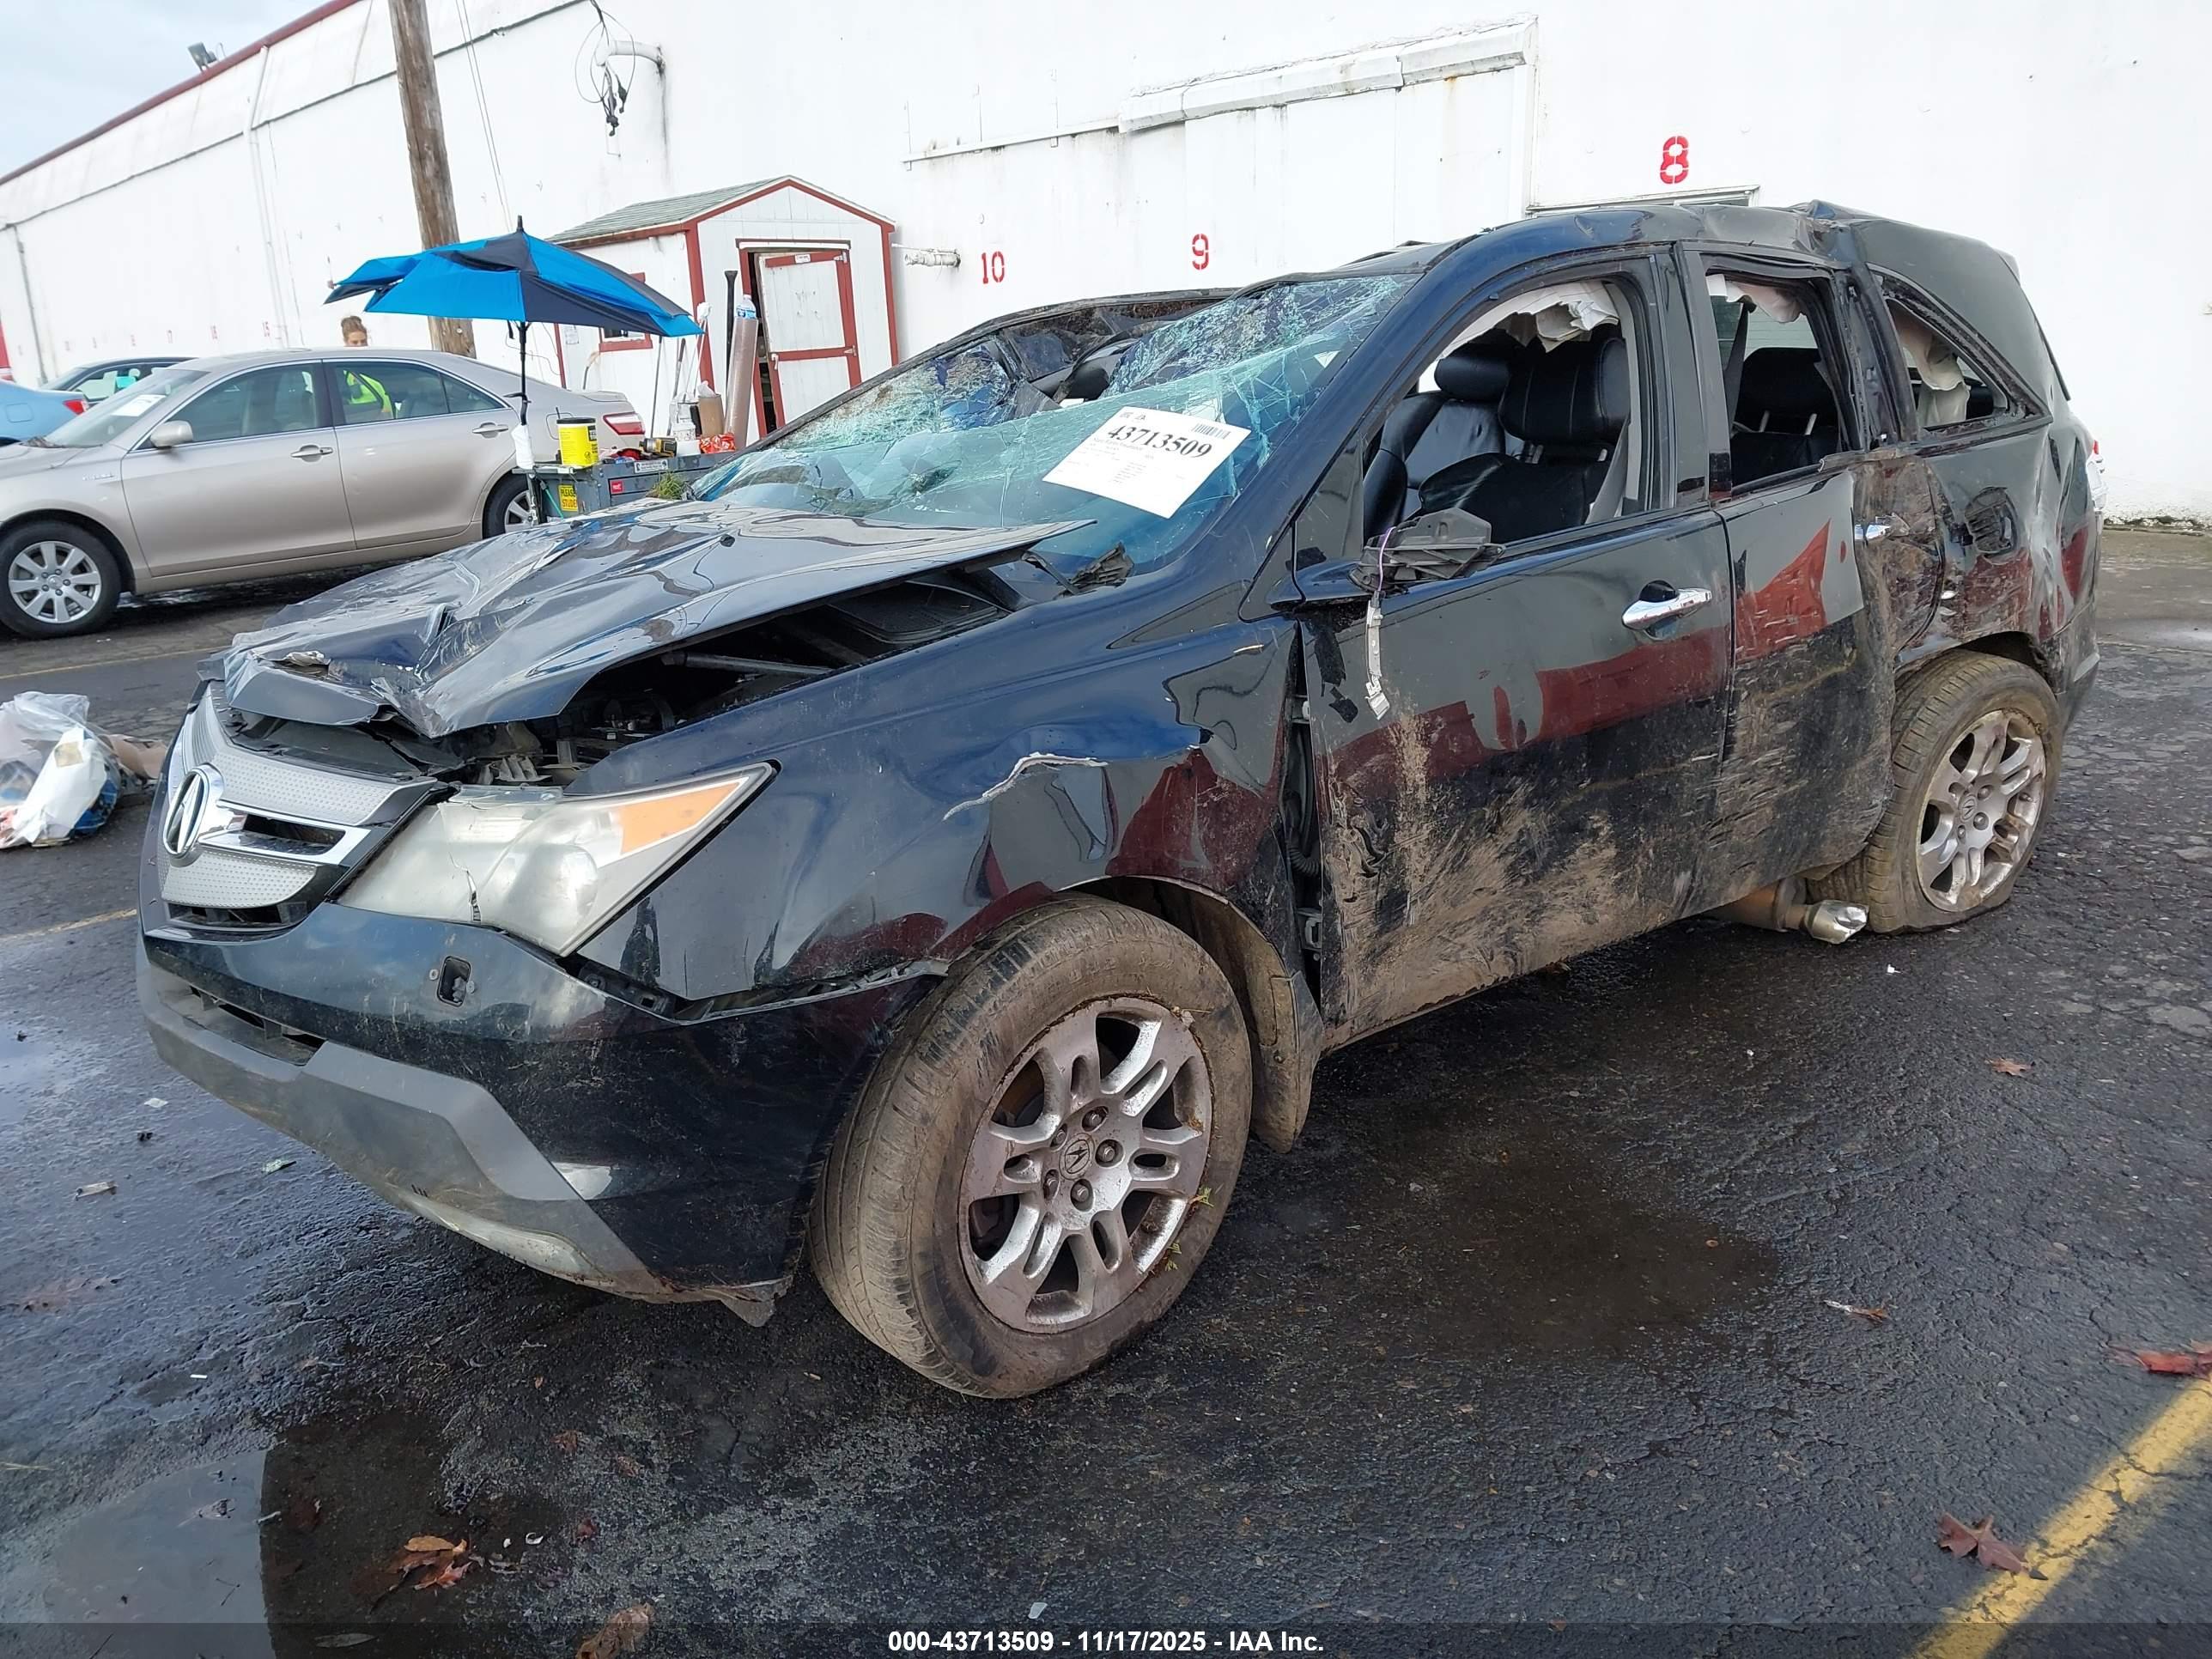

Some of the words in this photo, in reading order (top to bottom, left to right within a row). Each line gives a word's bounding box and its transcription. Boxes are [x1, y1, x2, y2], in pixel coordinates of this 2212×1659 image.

[1660, 136, 1689, 185] 8
[981, 252, 1006, 284] 10
[1192, 233, 1210, 270] 9
[1107, 424, 1213, 459] 43713509
